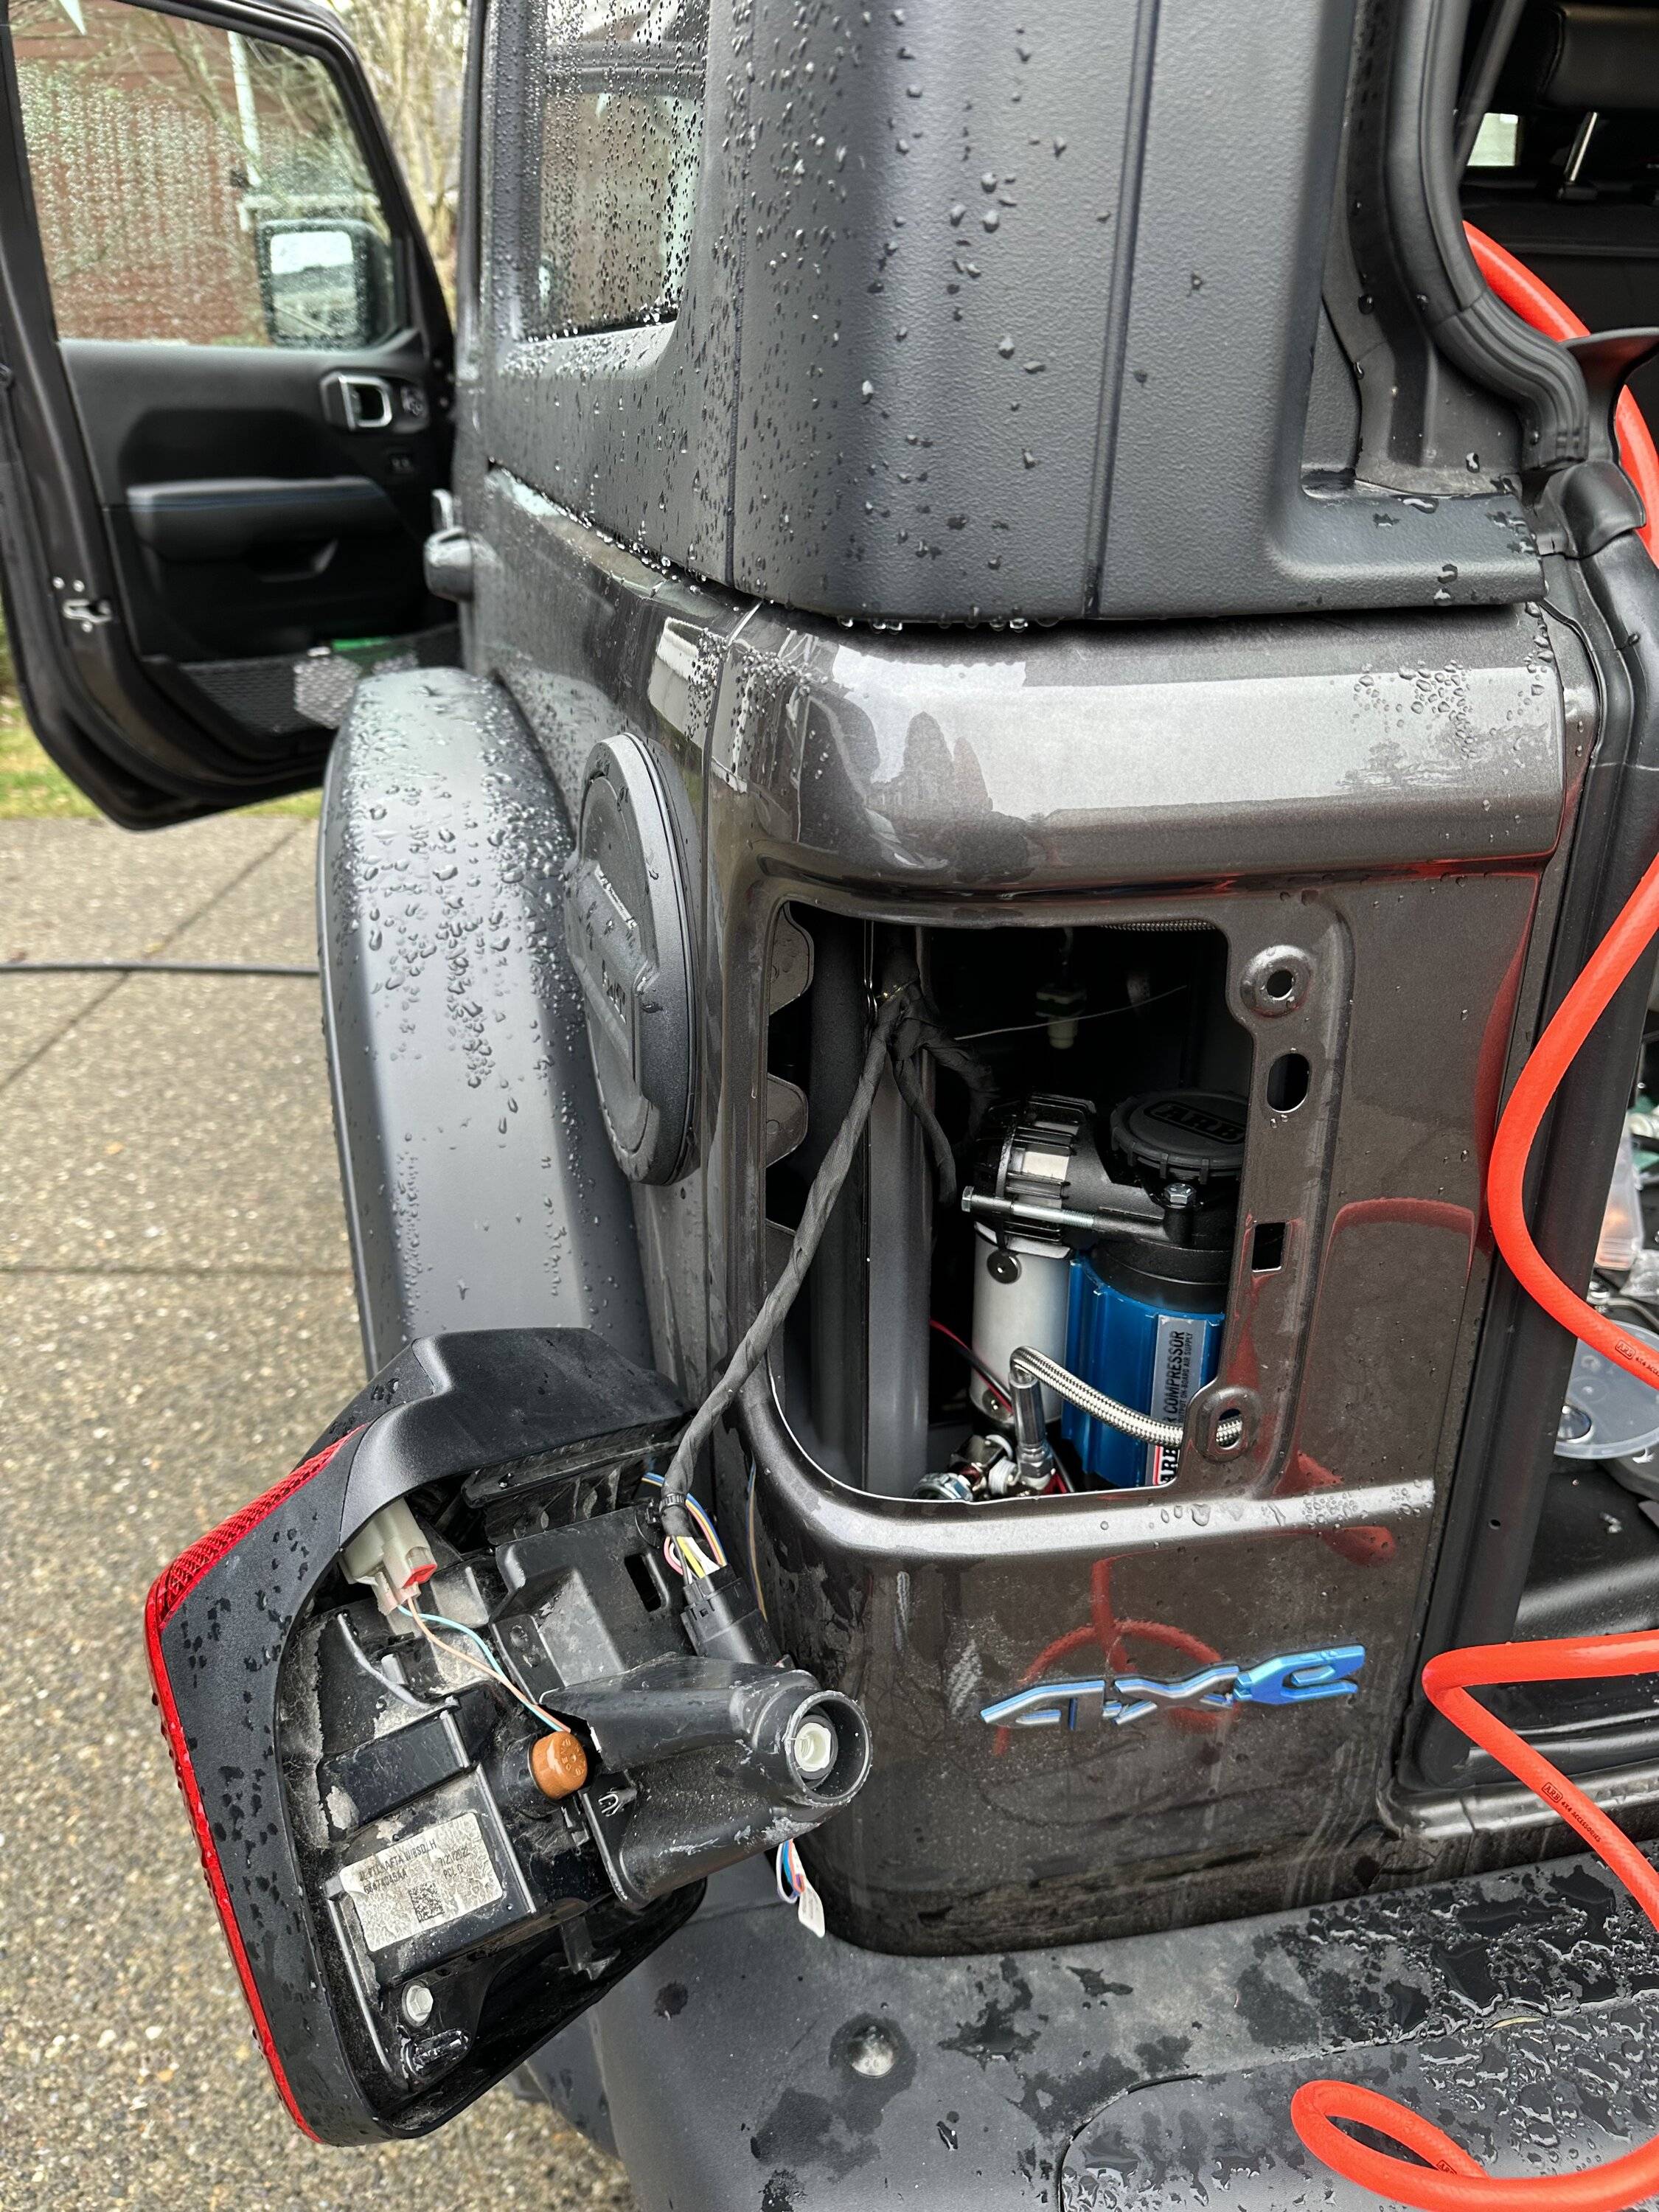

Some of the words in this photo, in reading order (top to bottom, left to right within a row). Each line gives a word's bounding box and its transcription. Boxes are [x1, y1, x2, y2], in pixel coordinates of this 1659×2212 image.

[1154, 1105, 1245, 1140] ARB
[1184, 1332, 1193, 1355] SUPPLY
[1617, 1343, 1634, 1357] ARB
[1163, 1330, 1185, 1414] COMPRESSOR
[1160, 1445, 1178, 1485] ARB
[1544, 1785, 1561, 1801] ARB
[1561, 1801, 1572, 1812] 4X4
[1571, 1812, 1601, 1842] ACCESSORIES
